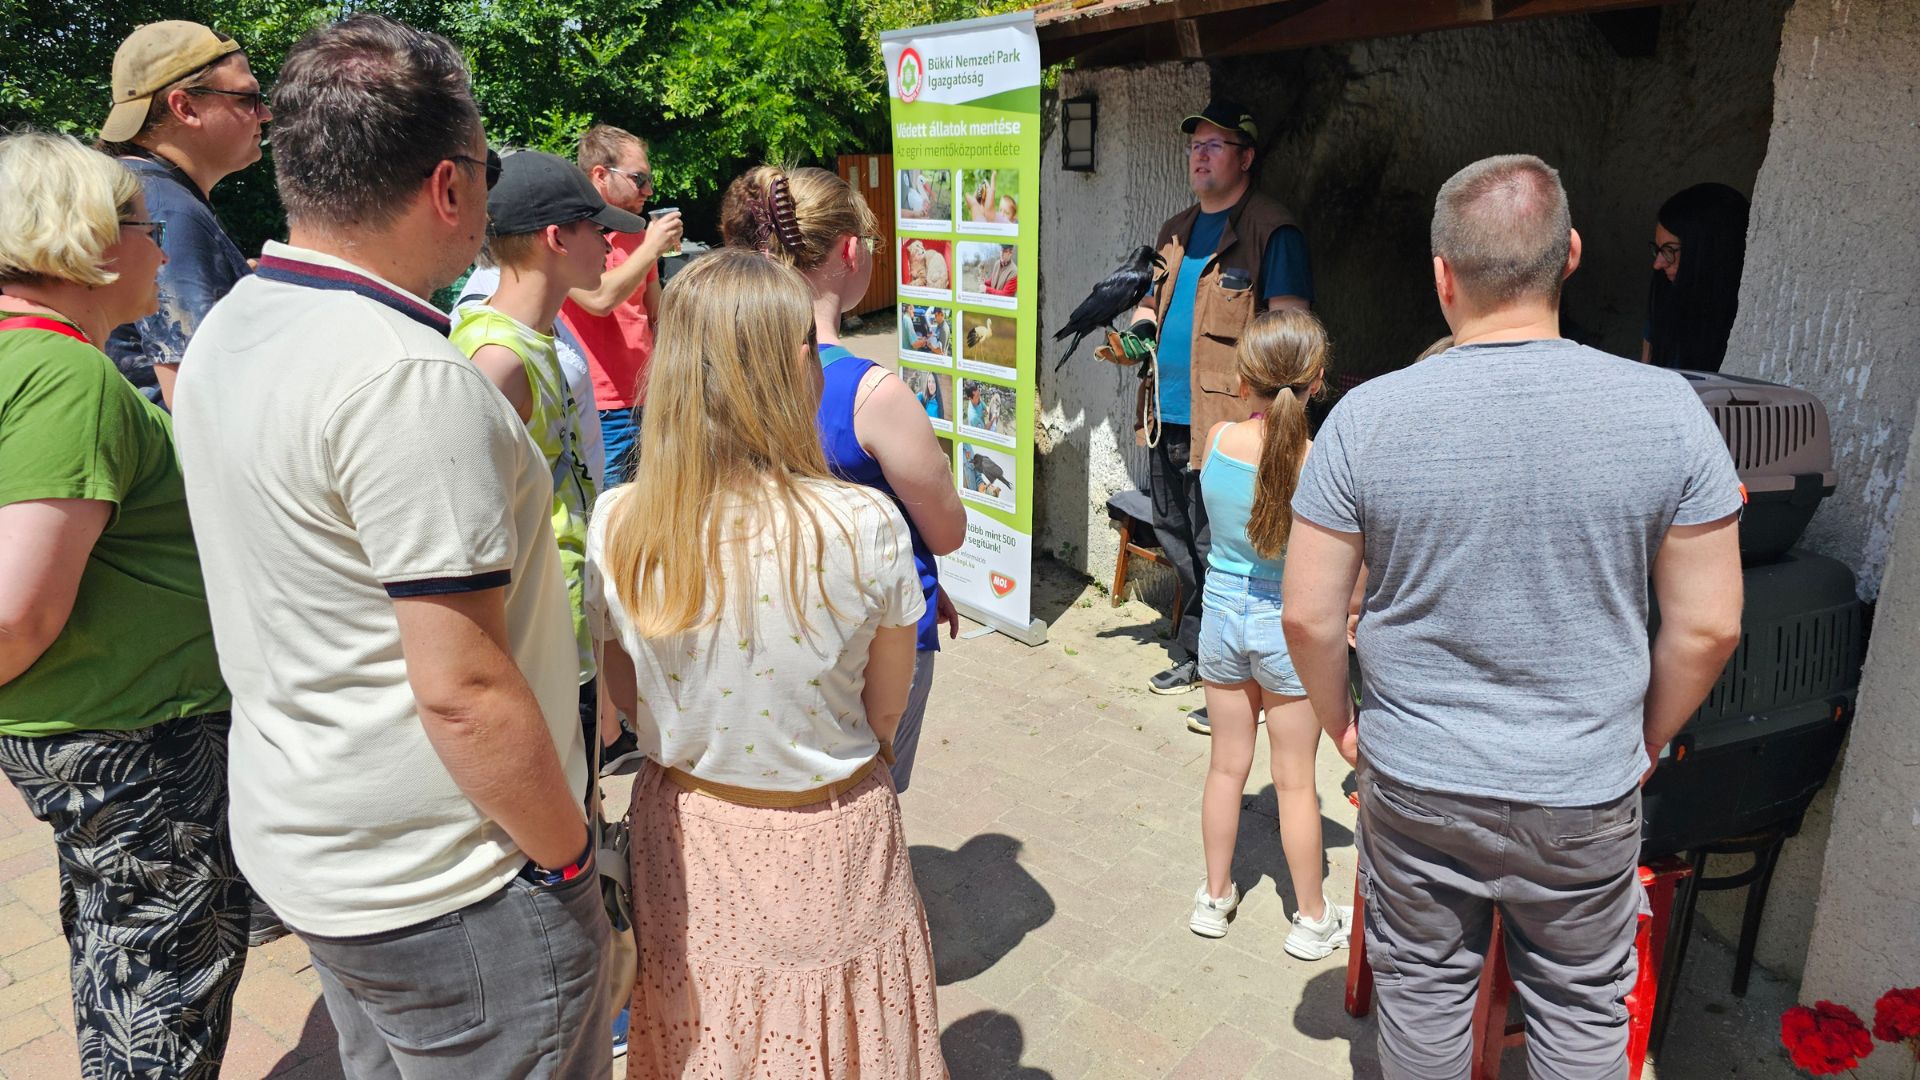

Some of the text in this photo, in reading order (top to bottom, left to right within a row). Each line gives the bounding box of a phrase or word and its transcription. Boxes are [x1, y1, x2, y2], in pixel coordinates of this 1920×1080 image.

[928, 48, 1021, 70] Bükki Nemzeti Park
[928, 71, 984, 91] Igazgatóság
[896, 117, 1021, 138] Védett állatok mentése
[896, 141, 1020, 160] Az egri mentőközpont élete
[969, 537, 1001, 553] segítünk!
[984, 530, 1002, 542] mint
[1002, 534, 1016, 548] 500
